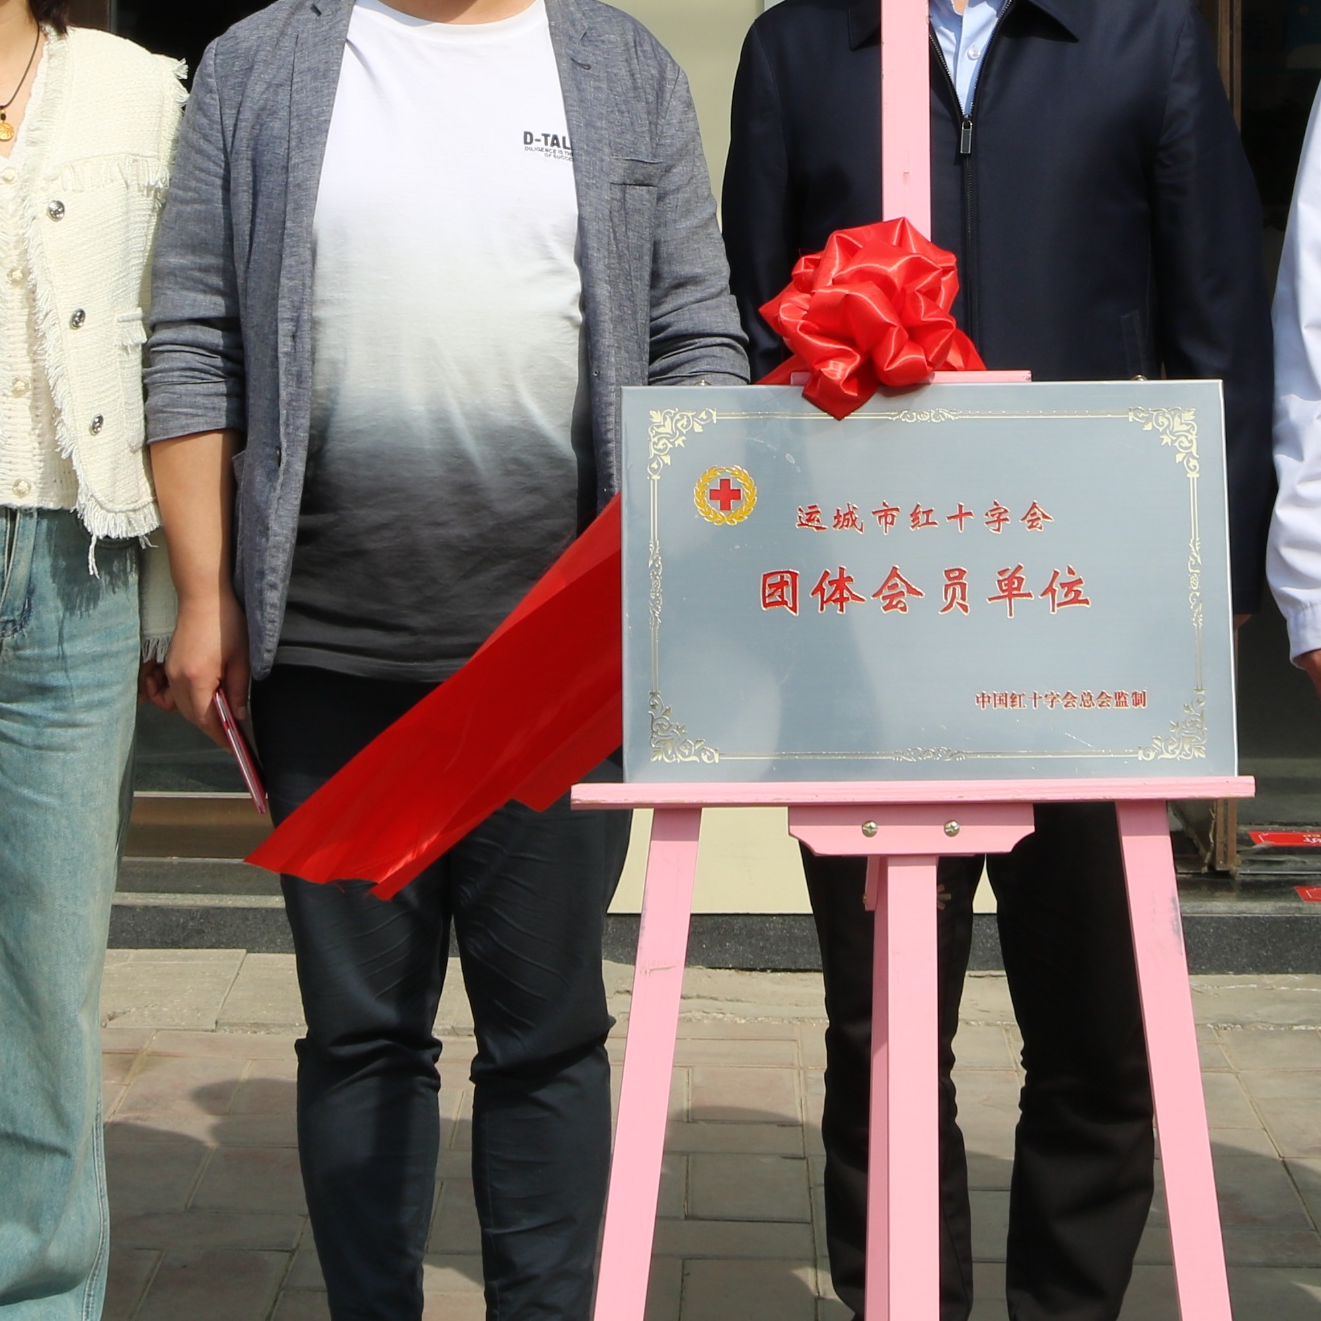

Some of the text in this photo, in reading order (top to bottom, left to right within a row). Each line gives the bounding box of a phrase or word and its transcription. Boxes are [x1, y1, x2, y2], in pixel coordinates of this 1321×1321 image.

[796, 499, 1055, 536] 运城市红十字会
[759, 563, 1093, 618] 团体会员单位
[975, 689, 1148, 712] 中国红十字会总会监制
